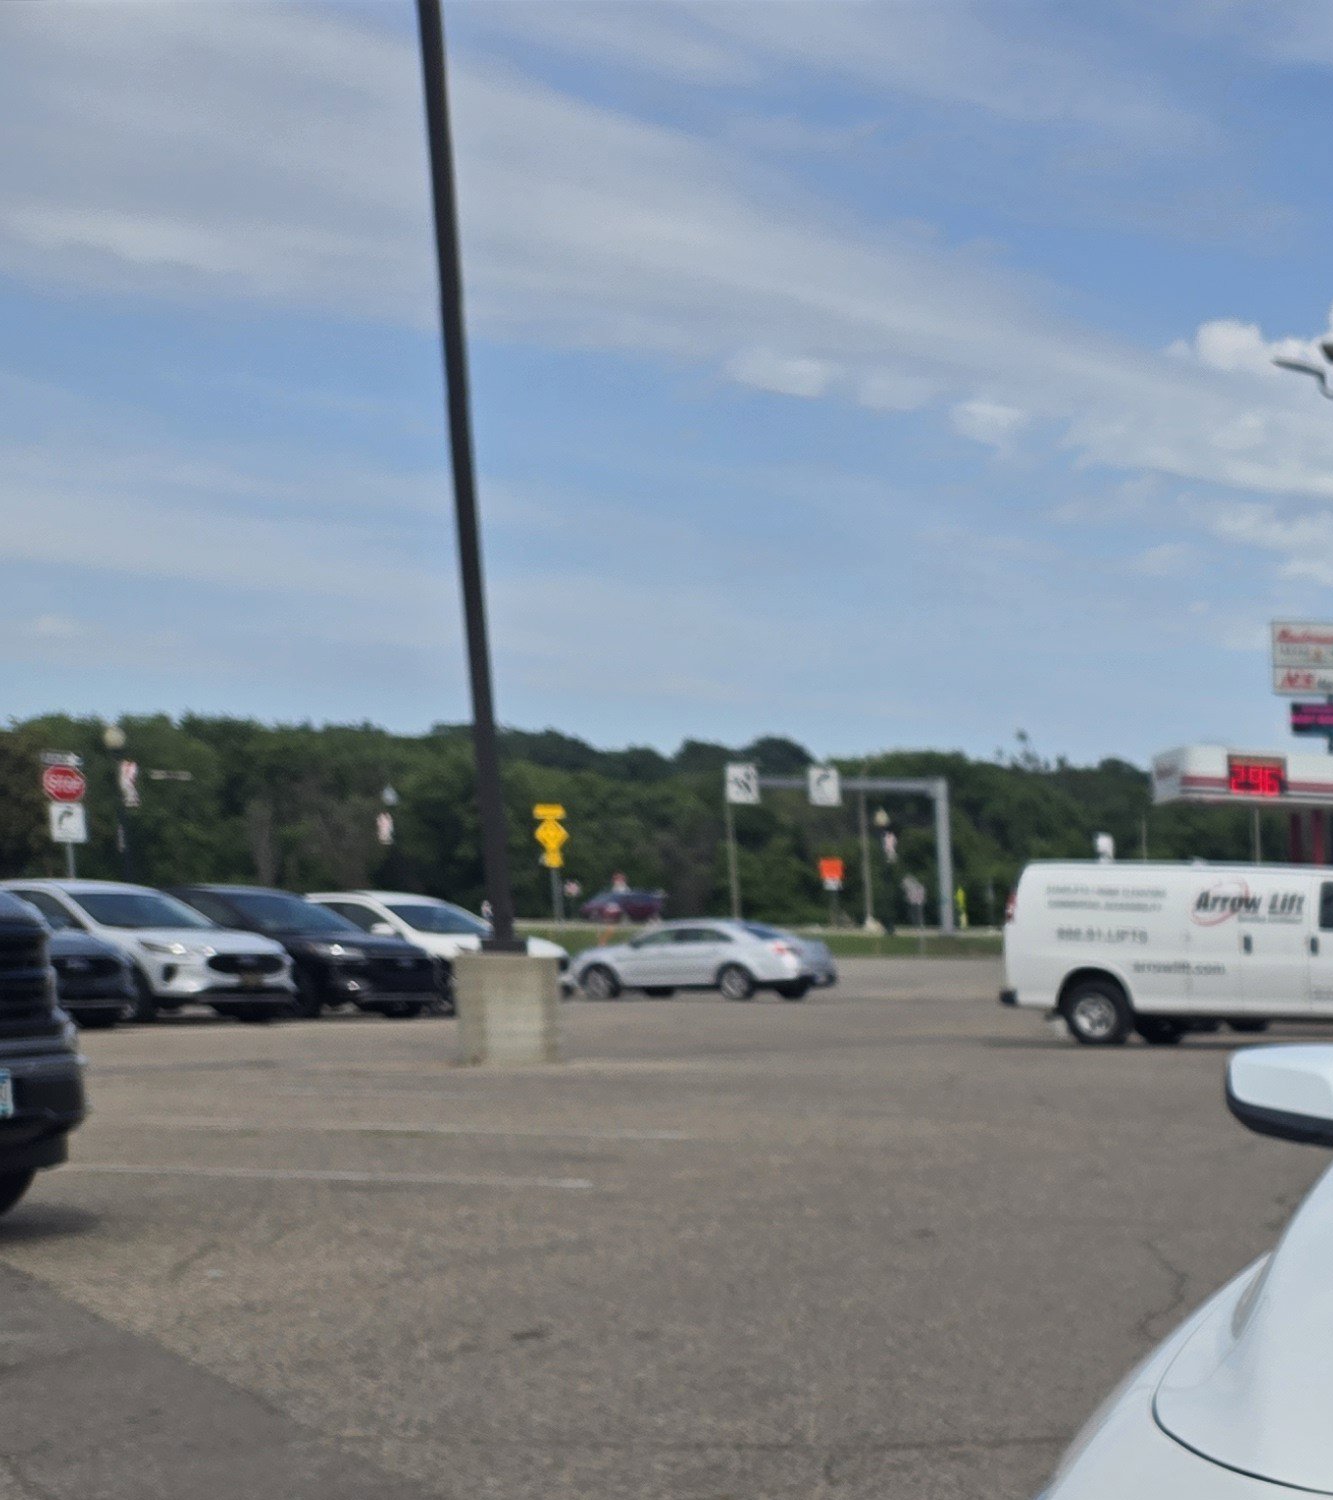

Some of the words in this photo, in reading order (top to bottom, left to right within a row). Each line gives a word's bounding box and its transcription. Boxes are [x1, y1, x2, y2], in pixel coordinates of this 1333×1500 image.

[47, 773, 82, 794] STOP
[1195, 891, 1262, 913] Arrow
[1267, 892, 1304, 915] Lift
